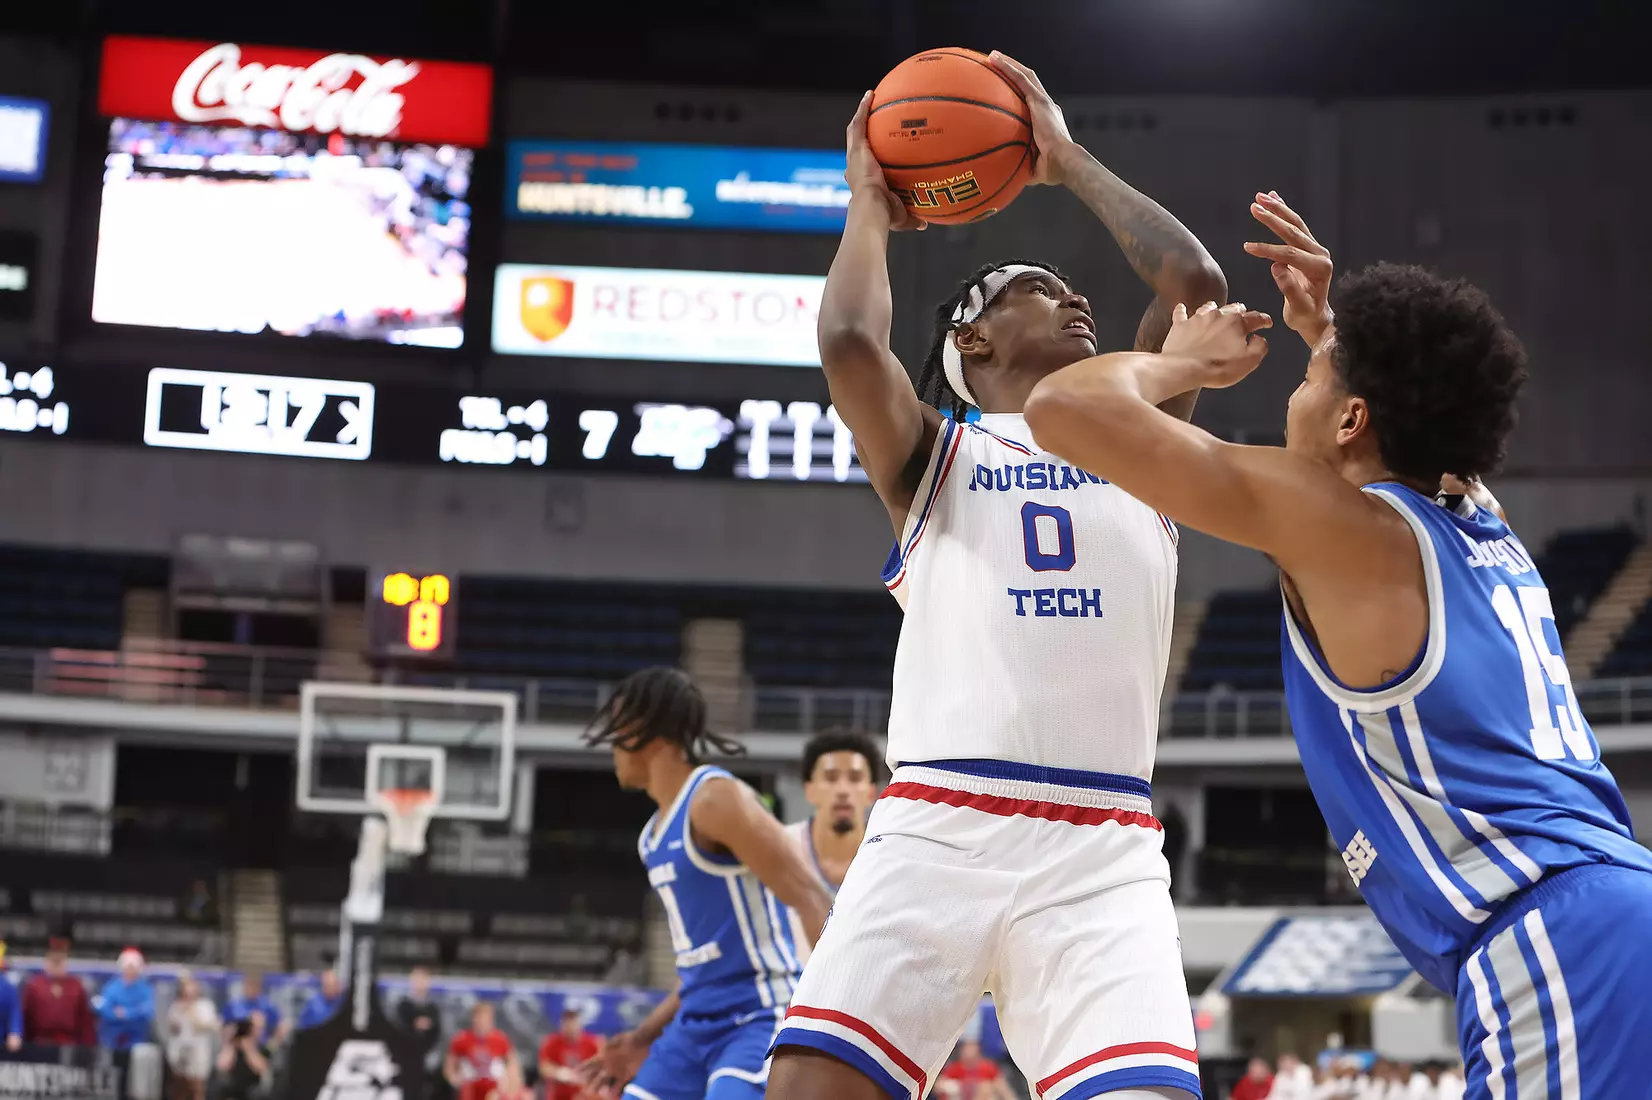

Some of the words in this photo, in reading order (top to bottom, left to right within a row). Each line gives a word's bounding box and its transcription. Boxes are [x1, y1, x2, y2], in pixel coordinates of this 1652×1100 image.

[968, 462, 1110, 492] OUISIAN
[1021, 501, 1076, 572] 0
[1007, 588, 1103, 618] TECH
[1491, 584, 1595, 761] 15
